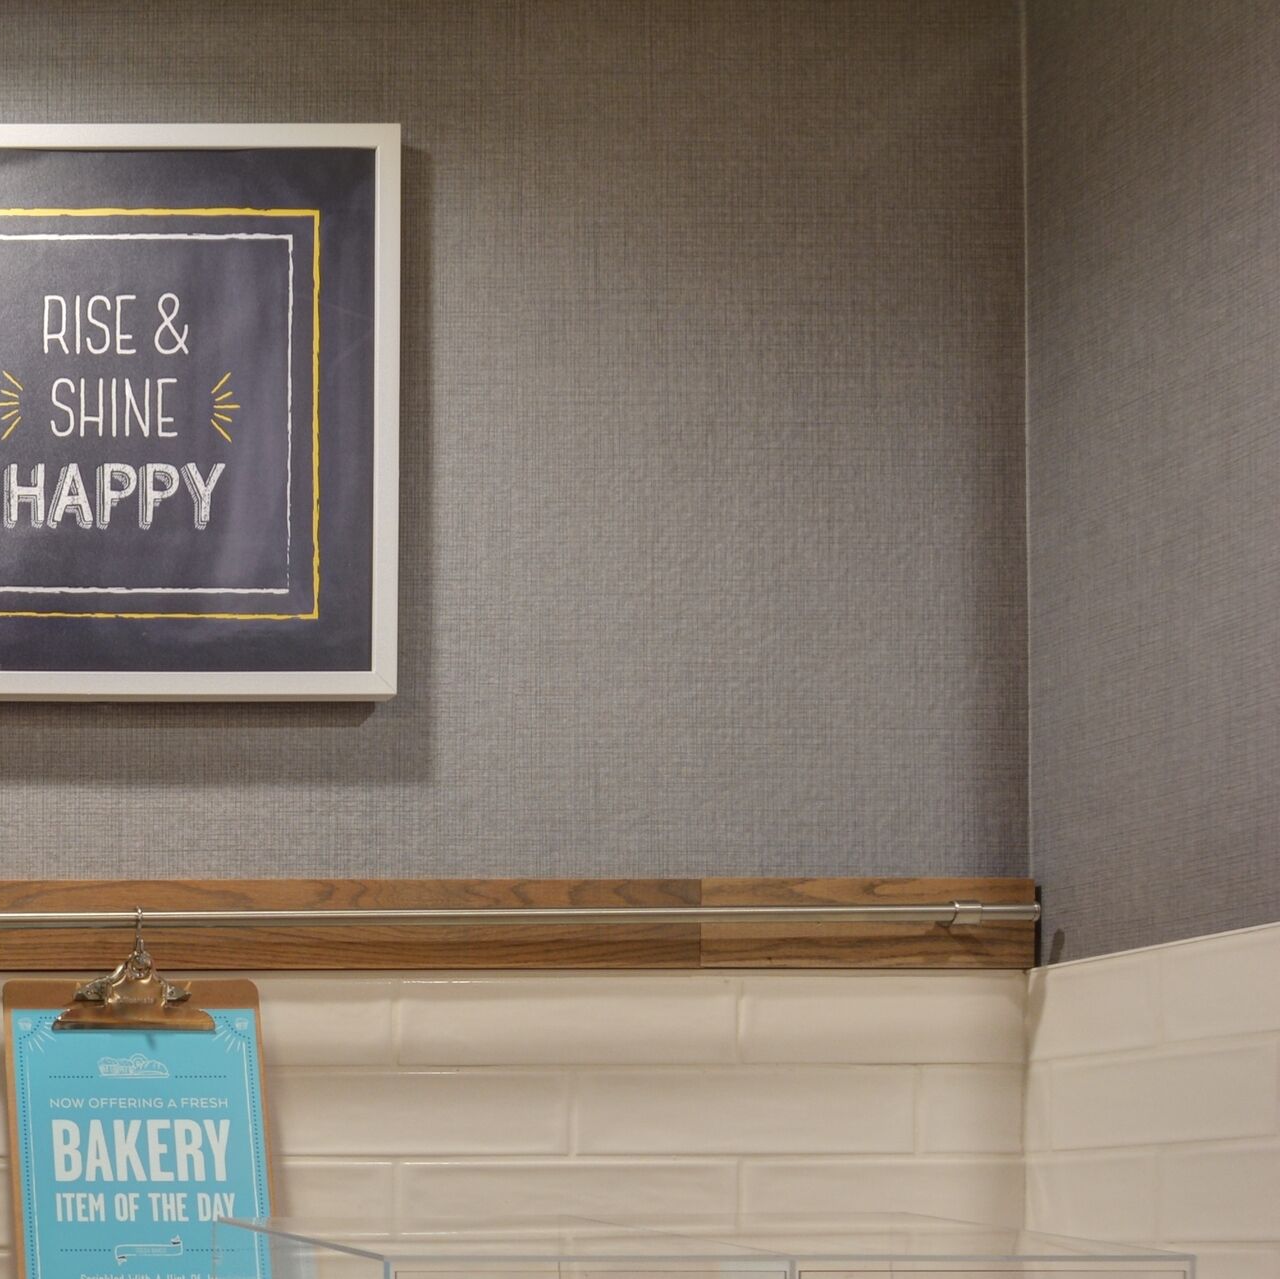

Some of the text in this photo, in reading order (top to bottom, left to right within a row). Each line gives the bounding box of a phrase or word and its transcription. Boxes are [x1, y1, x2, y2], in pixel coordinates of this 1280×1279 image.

[43, 293, 189, 355] RISE &
[50, 377, 178, 438] SHINE
[3, 462, 226, 530] HAPPY
[49, 1097, 228, 1109] NOW OFFERING A FRESH
[51, 1119, 231, 1182] BAKERY
[55, 1192, 235, 1222] ITEM OF THE DAY
